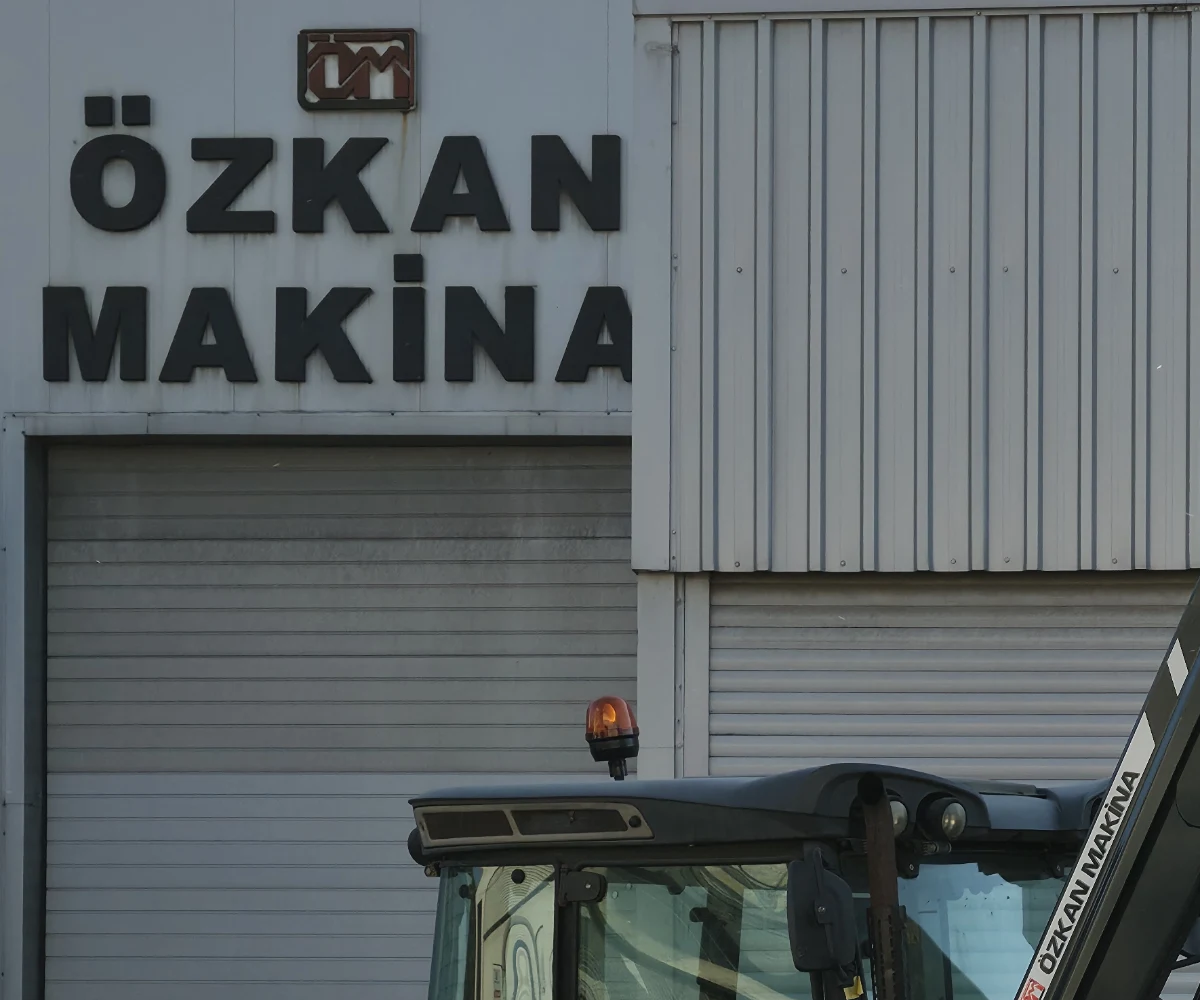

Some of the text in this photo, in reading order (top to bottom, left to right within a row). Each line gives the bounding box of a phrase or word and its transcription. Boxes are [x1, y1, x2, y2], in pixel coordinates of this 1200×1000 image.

[70, 95, 621, 233] ÖZKAN
[42, 253, 632, 384] MAKİNA
[1037, 879, 1090, 976] ÖZKAN
[1081, 770, 1141, 878] MAKİNA
